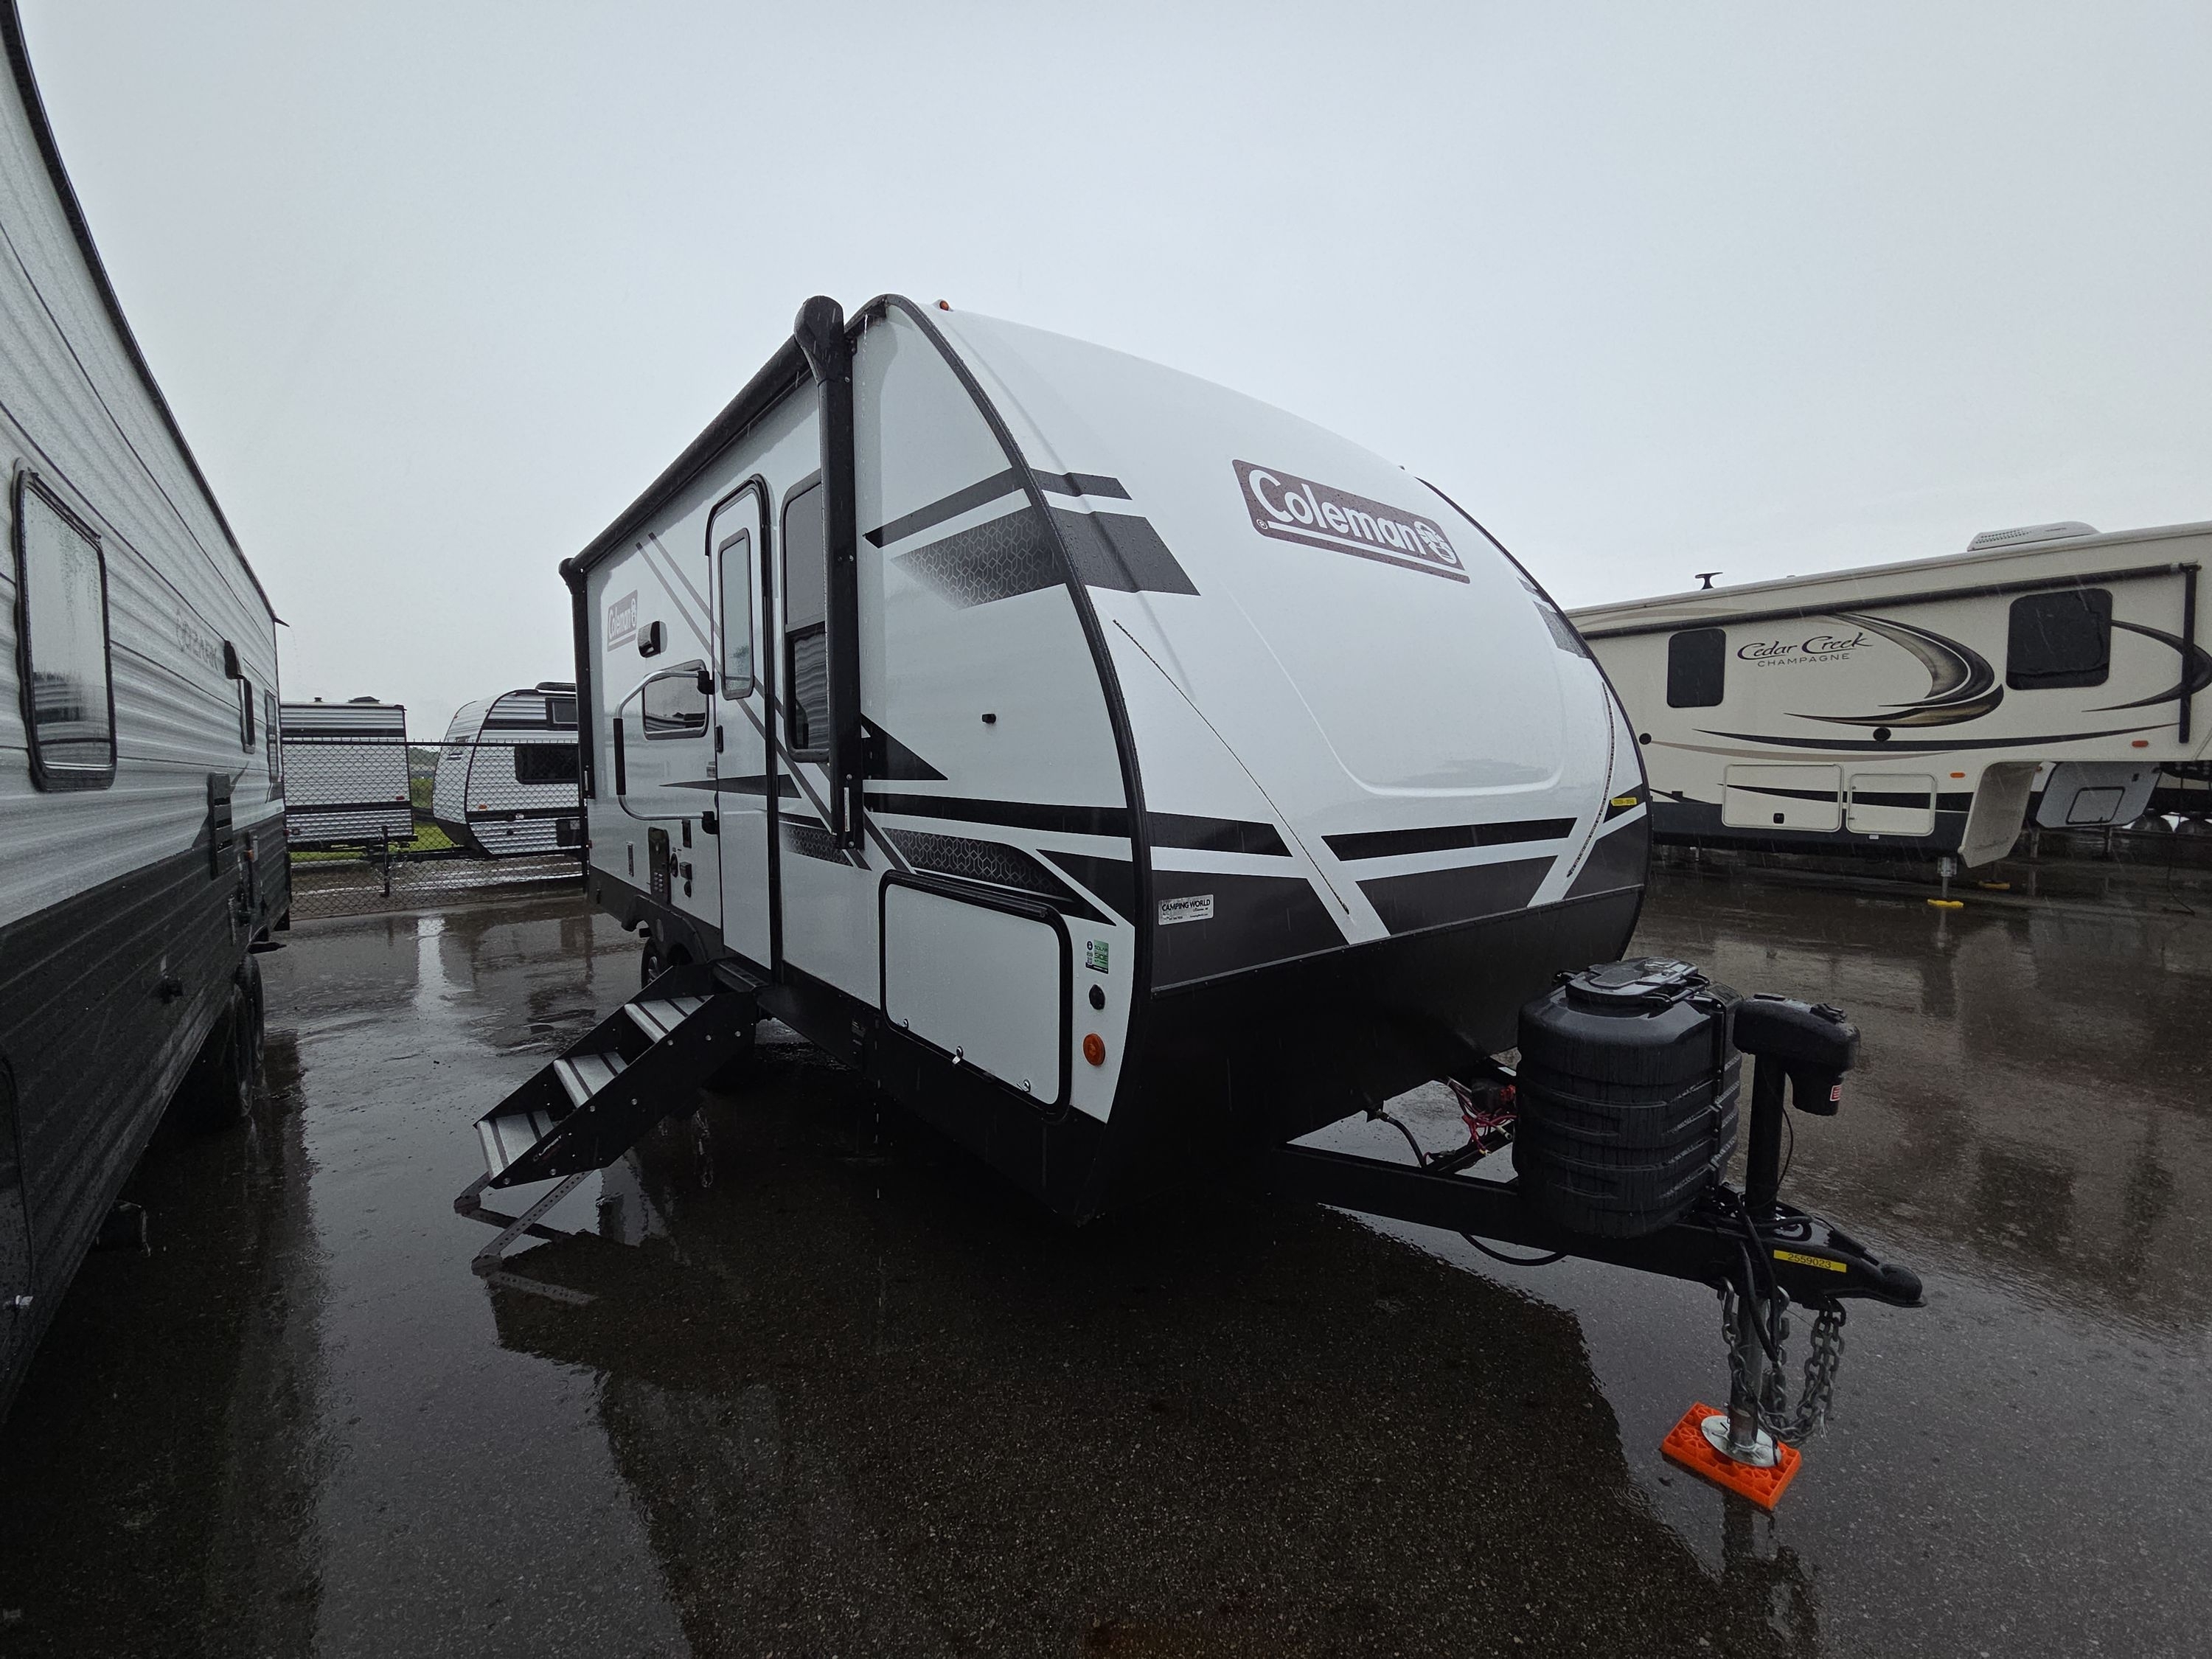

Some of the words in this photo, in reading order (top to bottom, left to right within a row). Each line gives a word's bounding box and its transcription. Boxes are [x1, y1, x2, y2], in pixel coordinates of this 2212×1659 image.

[1248, 469, 1427, 555] Coleman
[1737, 640, 1798, 661] Cedar
[1801, 632, 1874, 655] Creek
[1757, 653, 1851, 667] CHAMPAGNE
[1161, 901, 1189, 911] CAMPING
[1189, 899, 1211, 908] WORLD
[1787, 1253, 1832, 1269] 2559023
